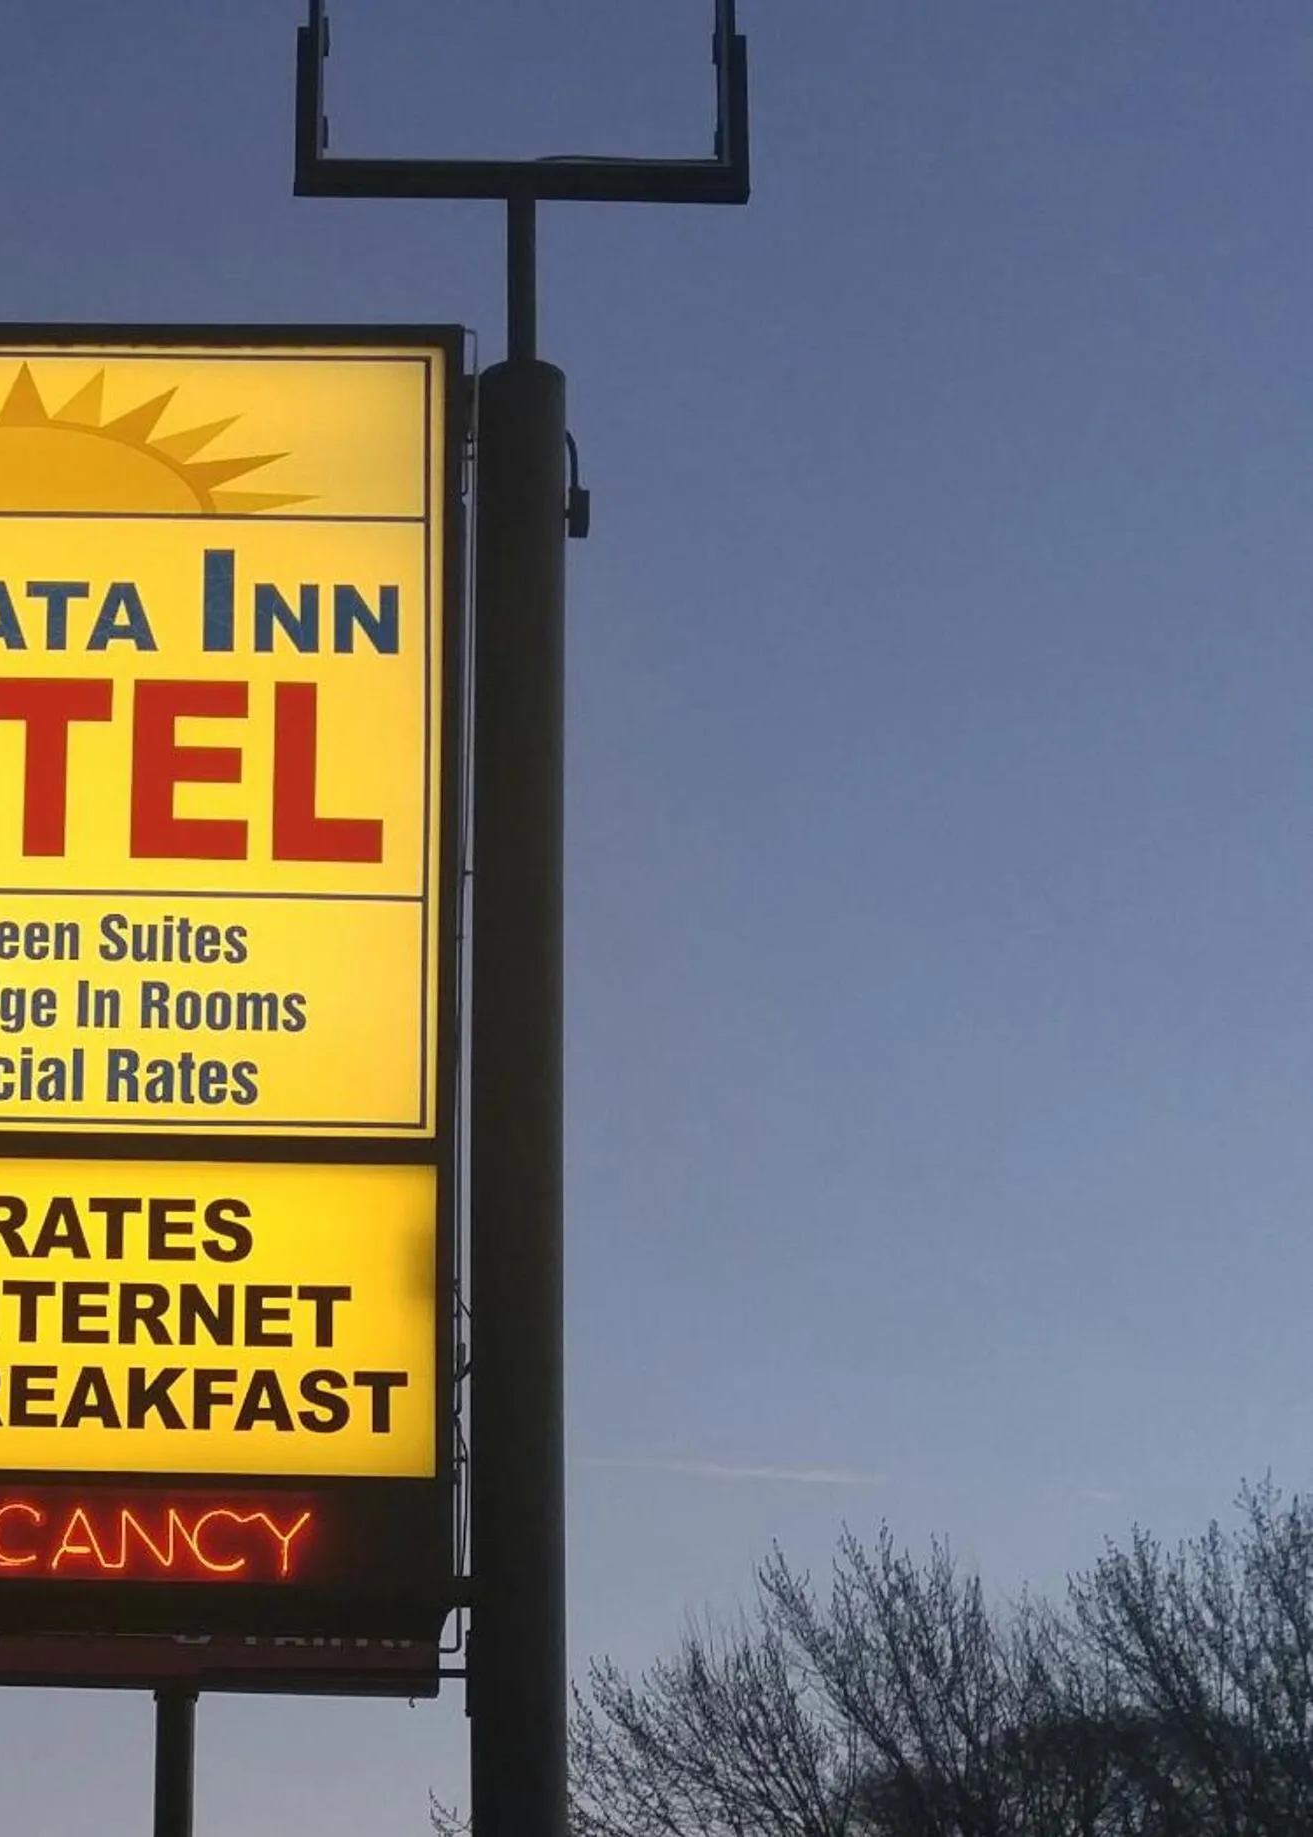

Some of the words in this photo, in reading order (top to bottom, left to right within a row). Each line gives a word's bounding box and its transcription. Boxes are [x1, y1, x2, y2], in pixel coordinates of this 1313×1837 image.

[99, 913, 247, 964] Suites
[77, 980, 120, 1029] In
[140, 981, 307, 1032] Rooms
[106, 1048, 258, 1106] Rates
